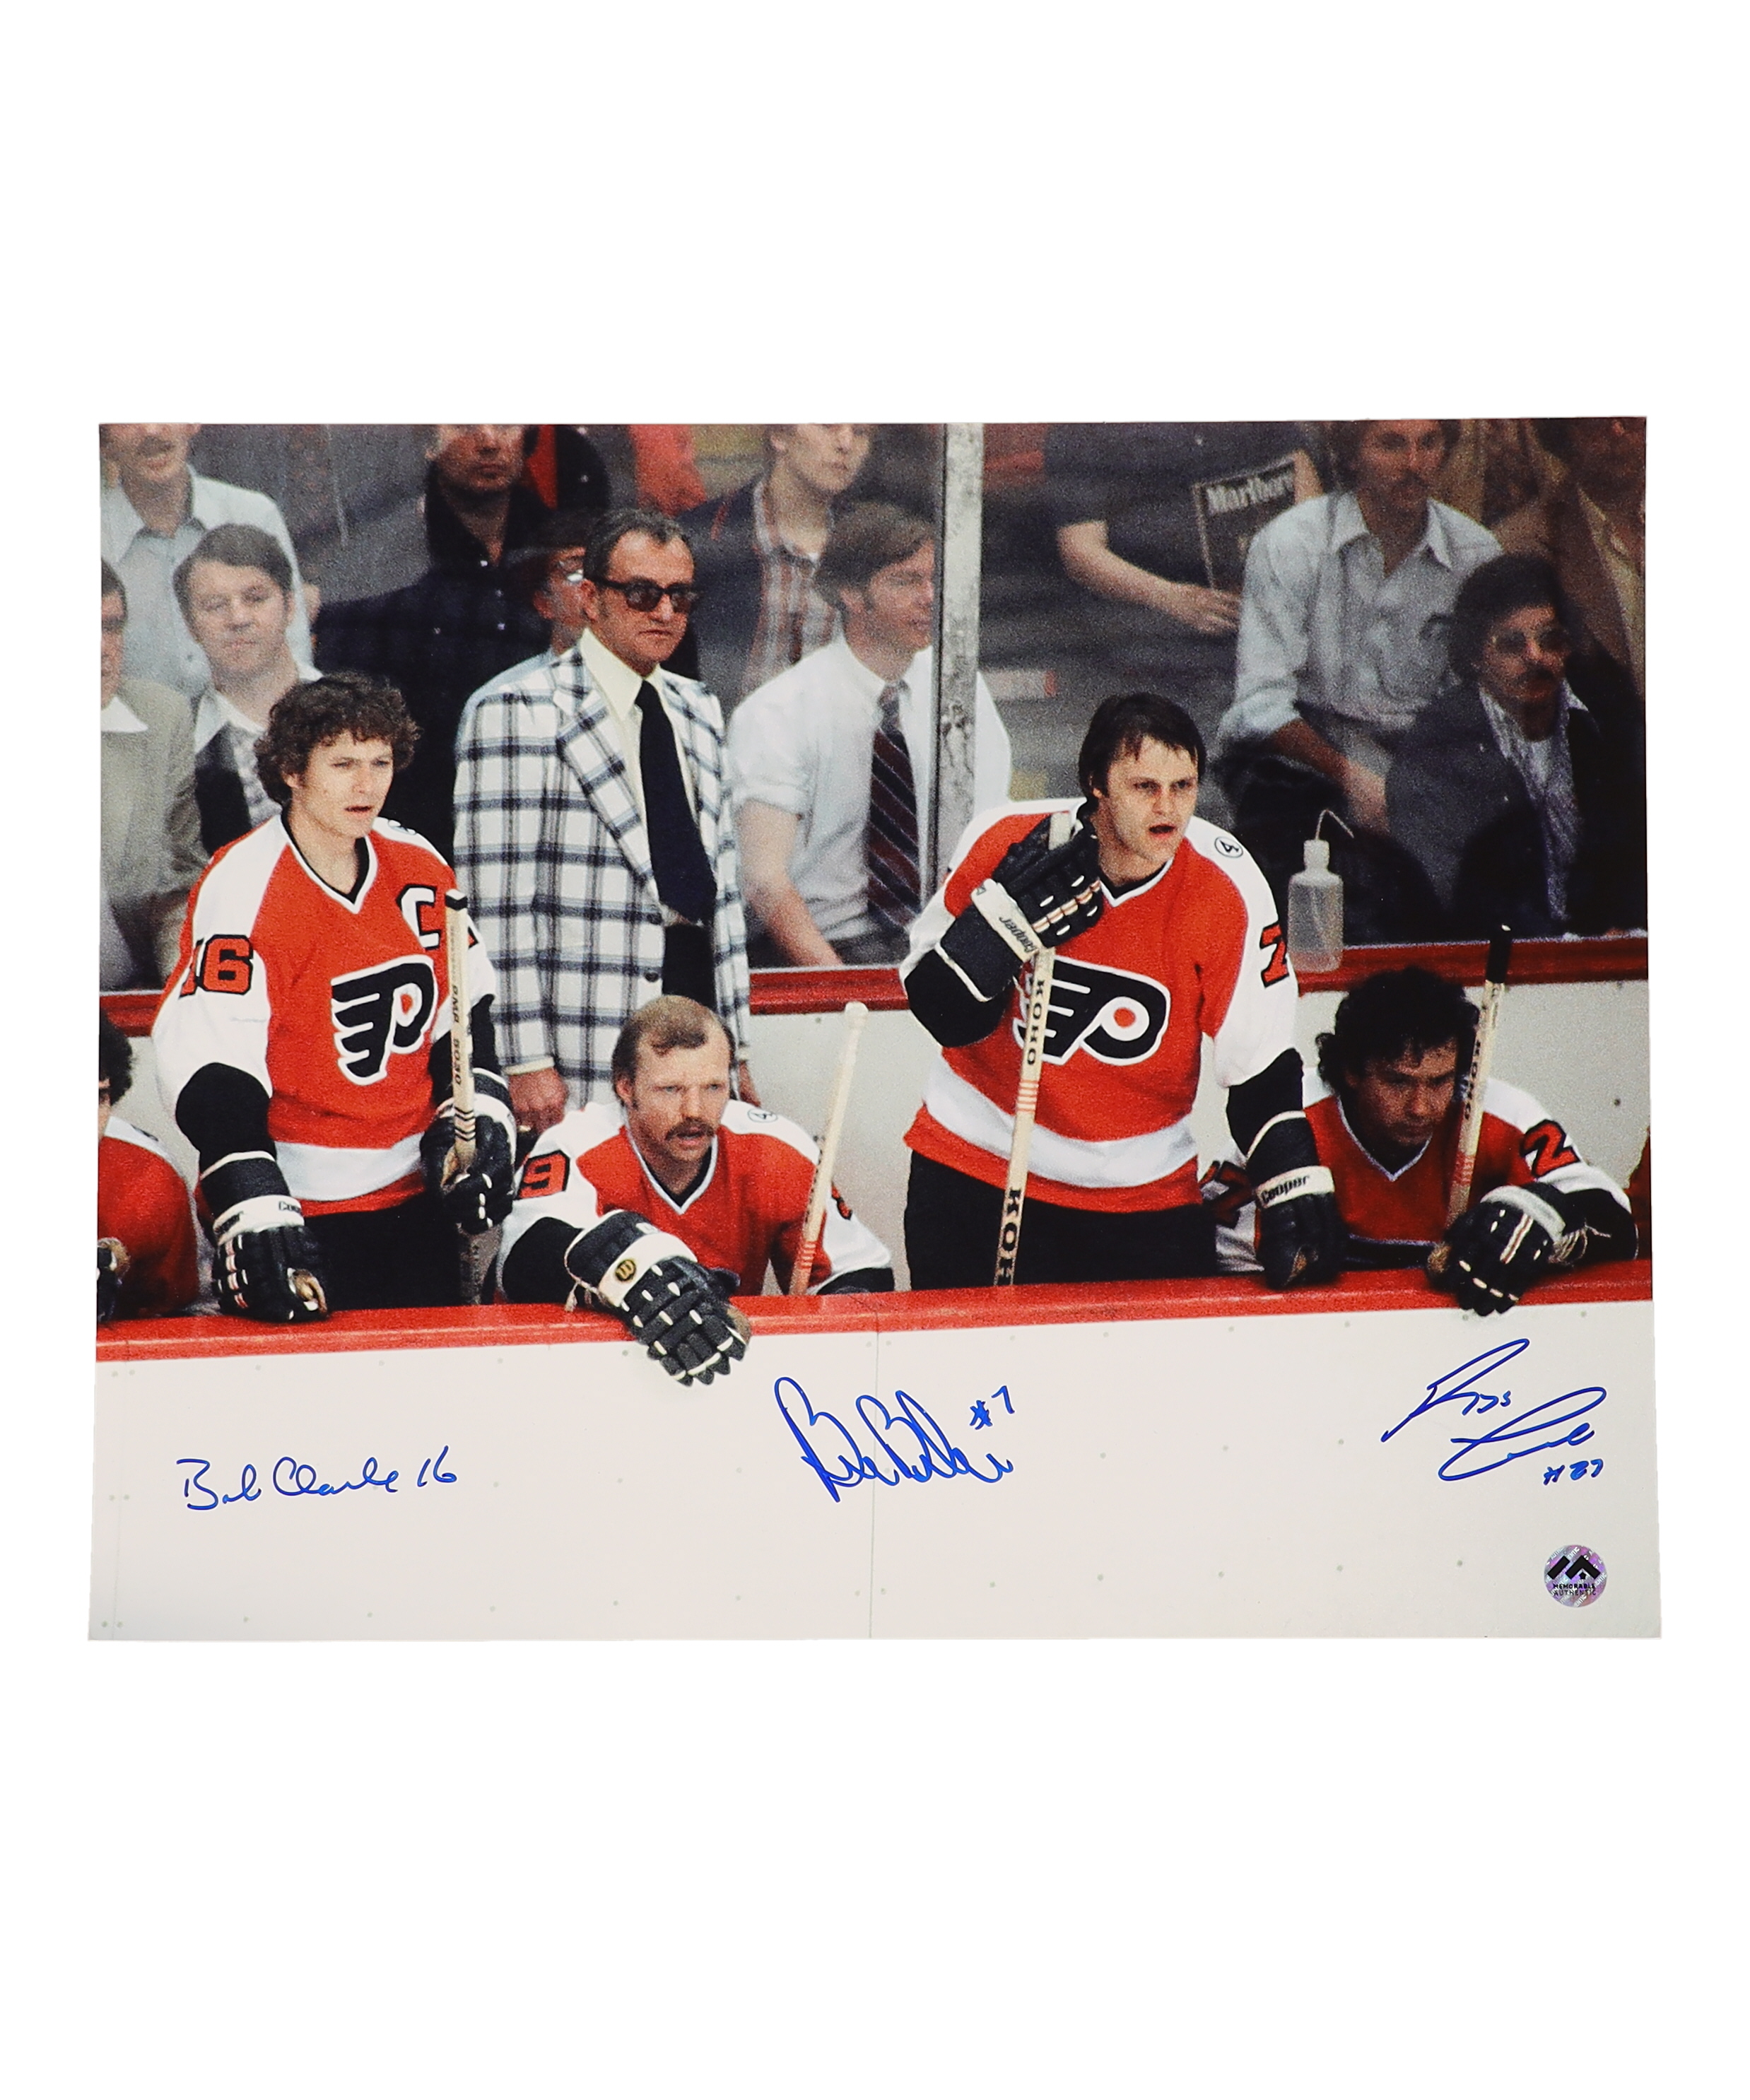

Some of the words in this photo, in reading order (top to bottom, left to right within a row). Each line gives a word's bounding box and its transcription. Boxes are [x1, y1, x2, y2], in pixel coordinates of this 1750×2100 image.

[1206, 468, 1294, 515] Marlbor
[396, 884, 441, 950] C
[1027, 980, 1045, 1065] KOHO
[1520, 1120, 1581, 1179] 2
[1261, 1175, 1310, 1204] Cooper
[997, 1190, 1021, 1285] KOH
[417, 1445, 458, 1487] 16
